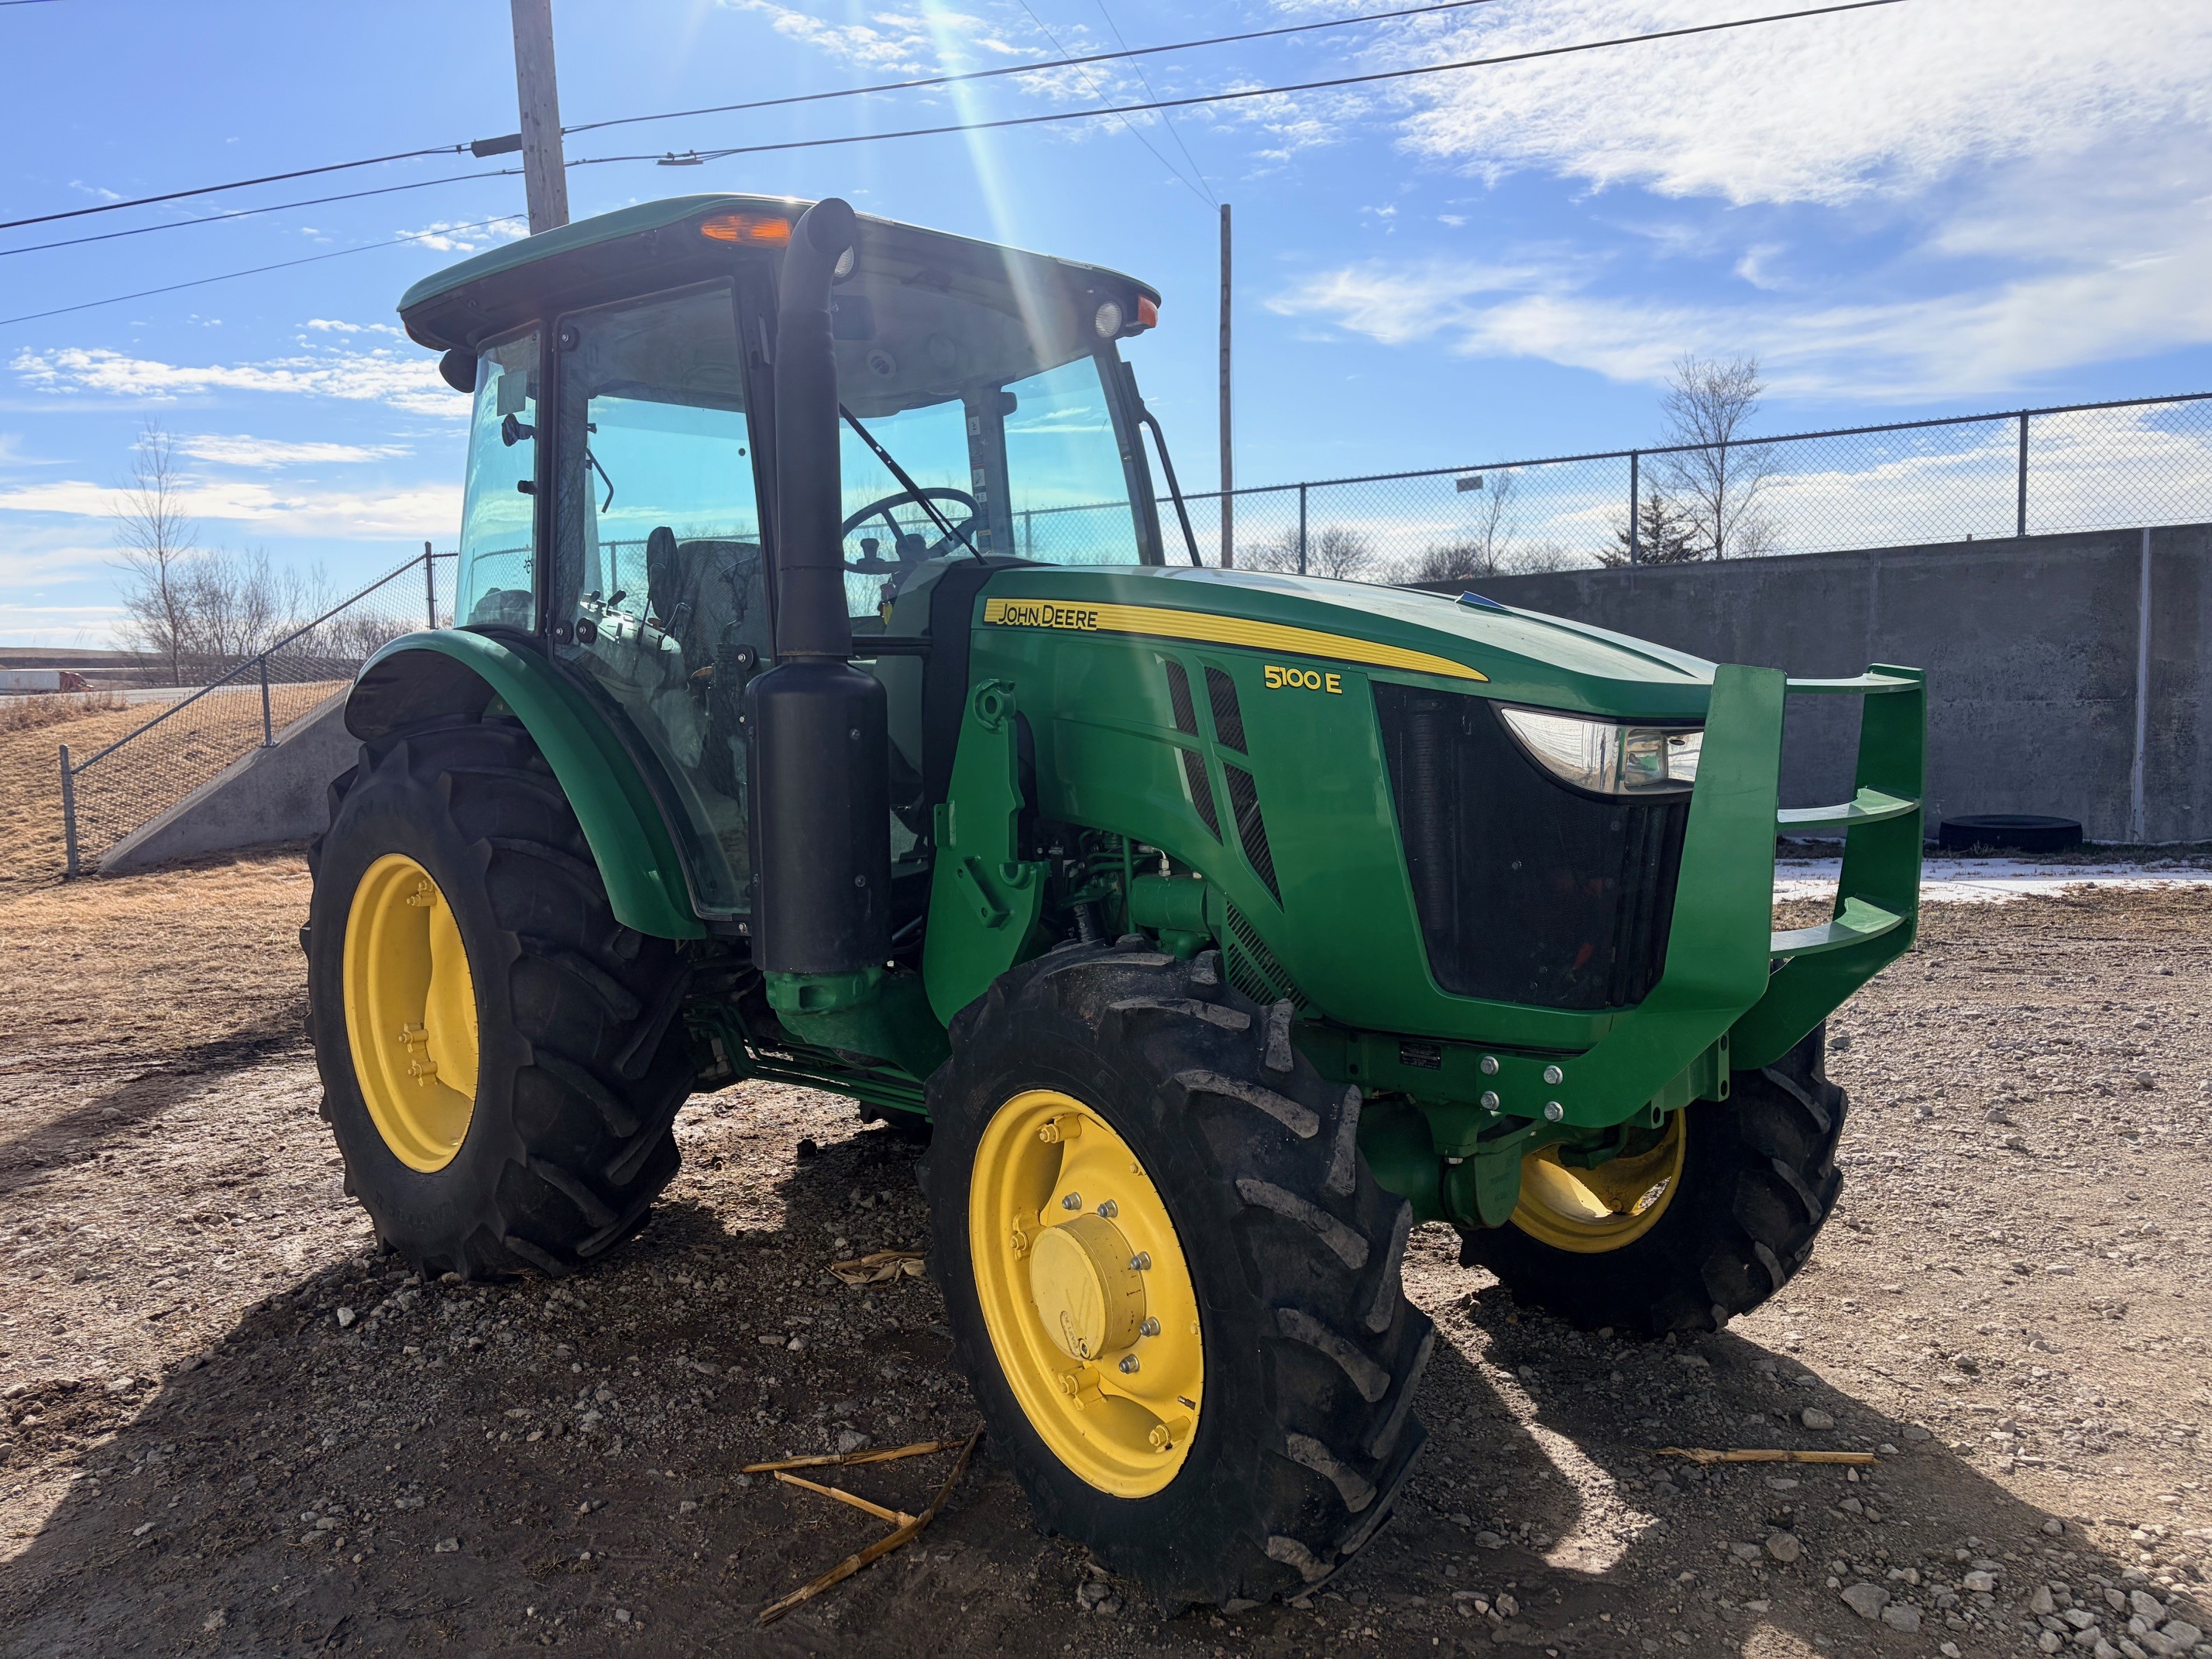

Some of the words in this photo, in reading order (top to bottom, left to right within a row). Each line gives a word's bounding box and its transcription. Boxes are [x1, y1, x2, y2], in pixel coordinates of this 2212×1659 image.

[998, 603, 1039, 623] JOHN
[1042, 605, 1098, 628] DEERE
[1264, 665, 1321, 690] 5100
[1324, 672, 1343, 694] E
